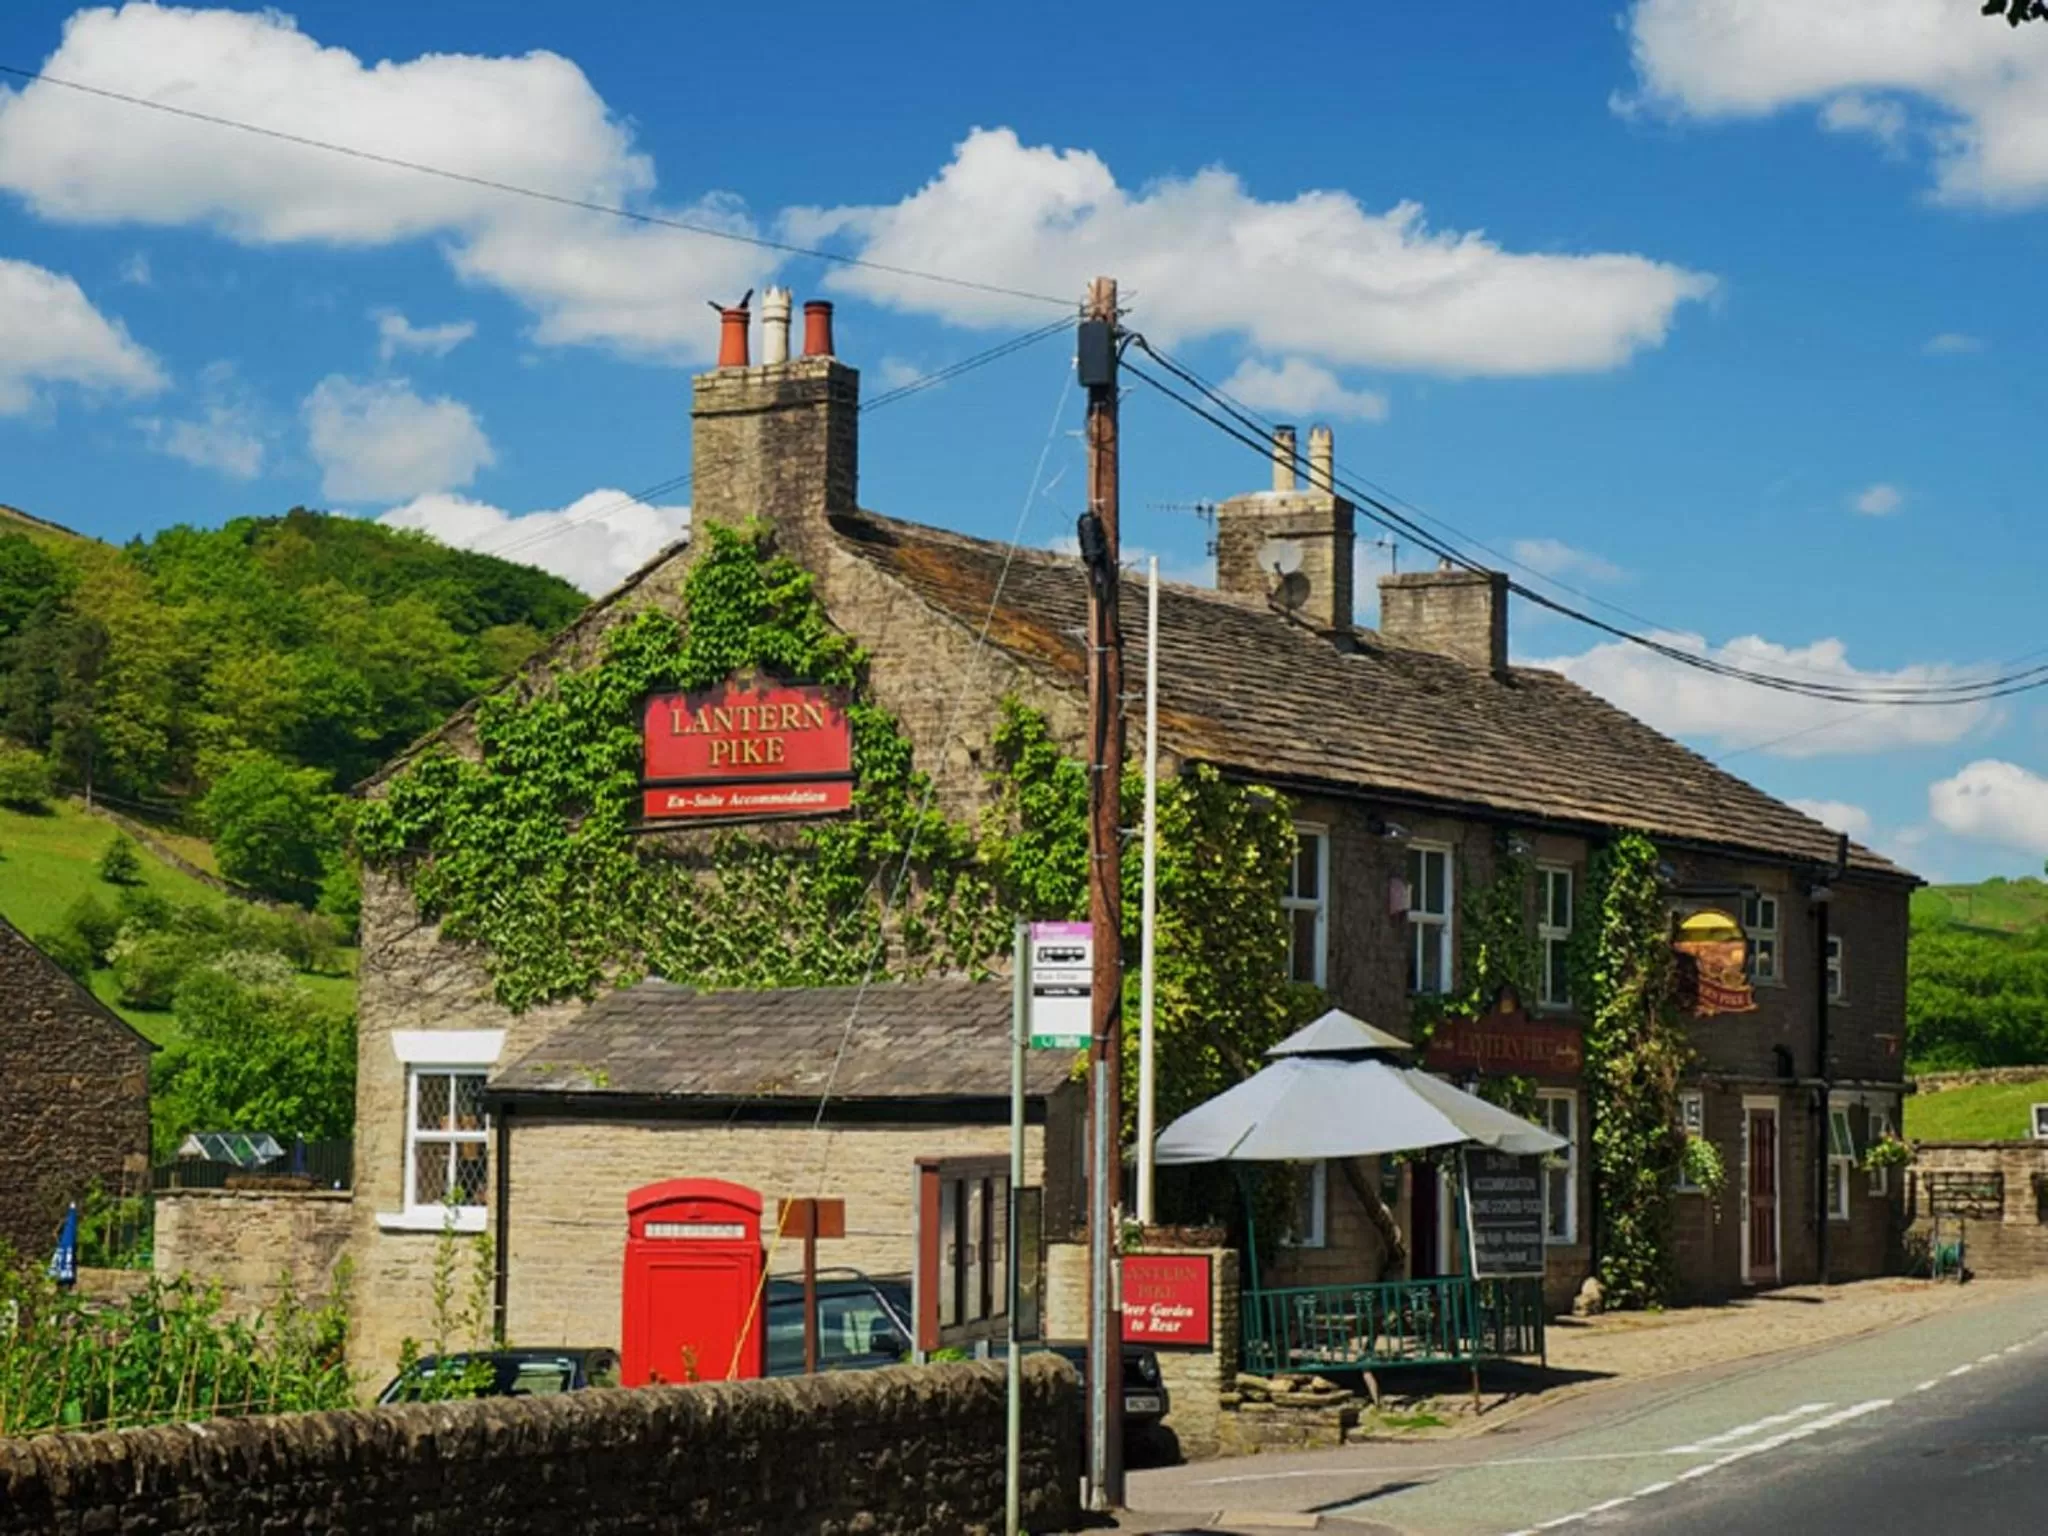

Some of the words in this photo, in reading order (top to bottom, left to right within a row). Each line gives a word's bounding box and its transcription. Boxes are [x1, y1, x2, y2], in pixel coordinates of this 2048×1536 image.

[671, 702, 824, 735] LANTERN
[709, 737, 785, 766] PIKE
[728, 790, 828, 807] Accommodation
[1149, 1301, 1194, 1317] Garden
[1131, 1319, 1145, 1333] to
[1148, 1316, 1182, 1333] Rear
